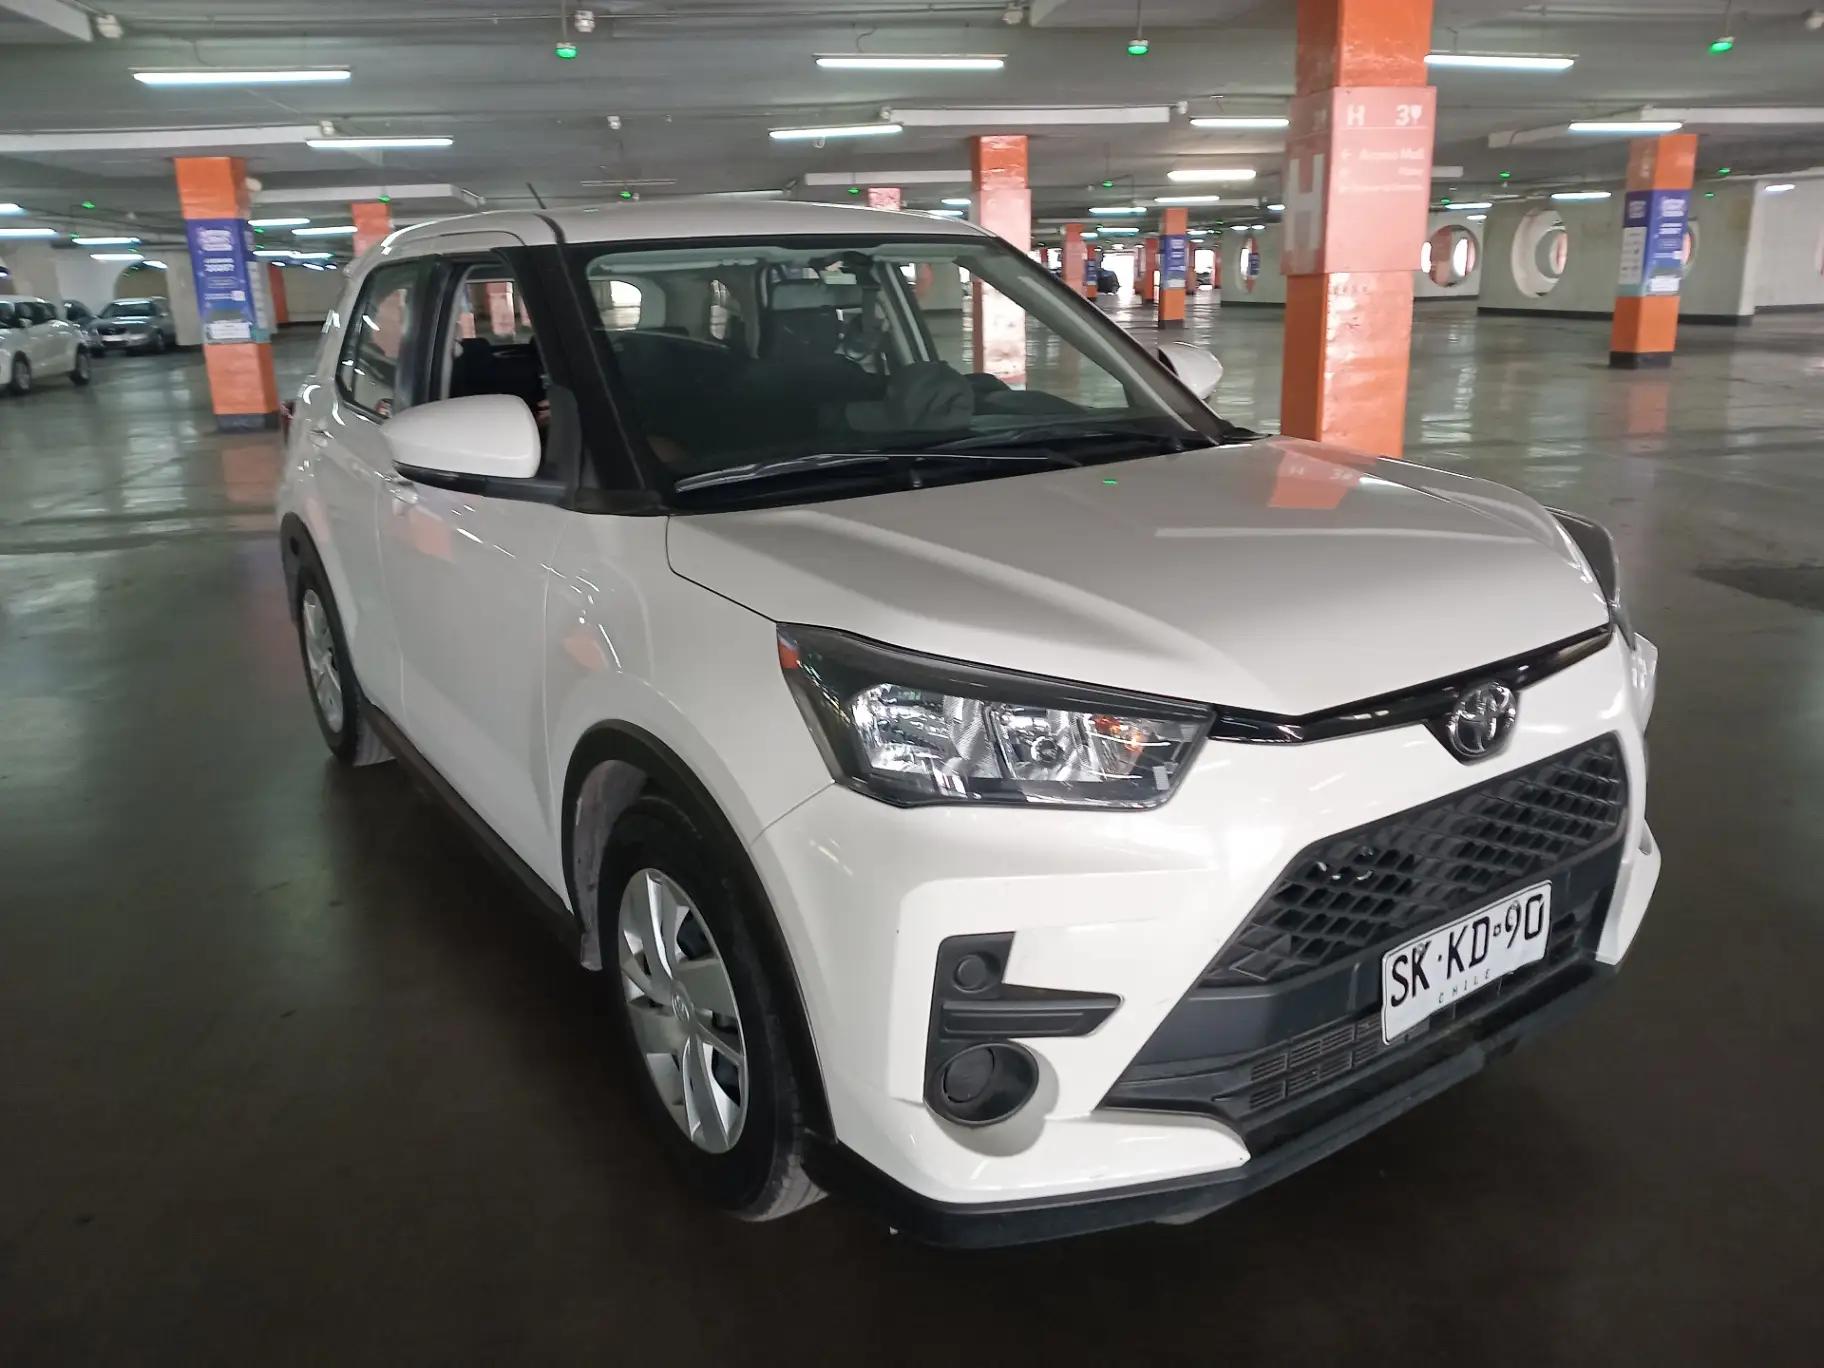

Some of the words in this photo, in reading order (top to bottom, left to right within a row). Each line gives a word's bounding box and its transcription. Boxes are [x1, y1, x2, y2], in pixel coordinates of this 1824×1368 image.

[1347, 104, 1366, 126] H
[1284, 153, 1326, 252] H
[1438, 968, 1491, 1004] CHILE
